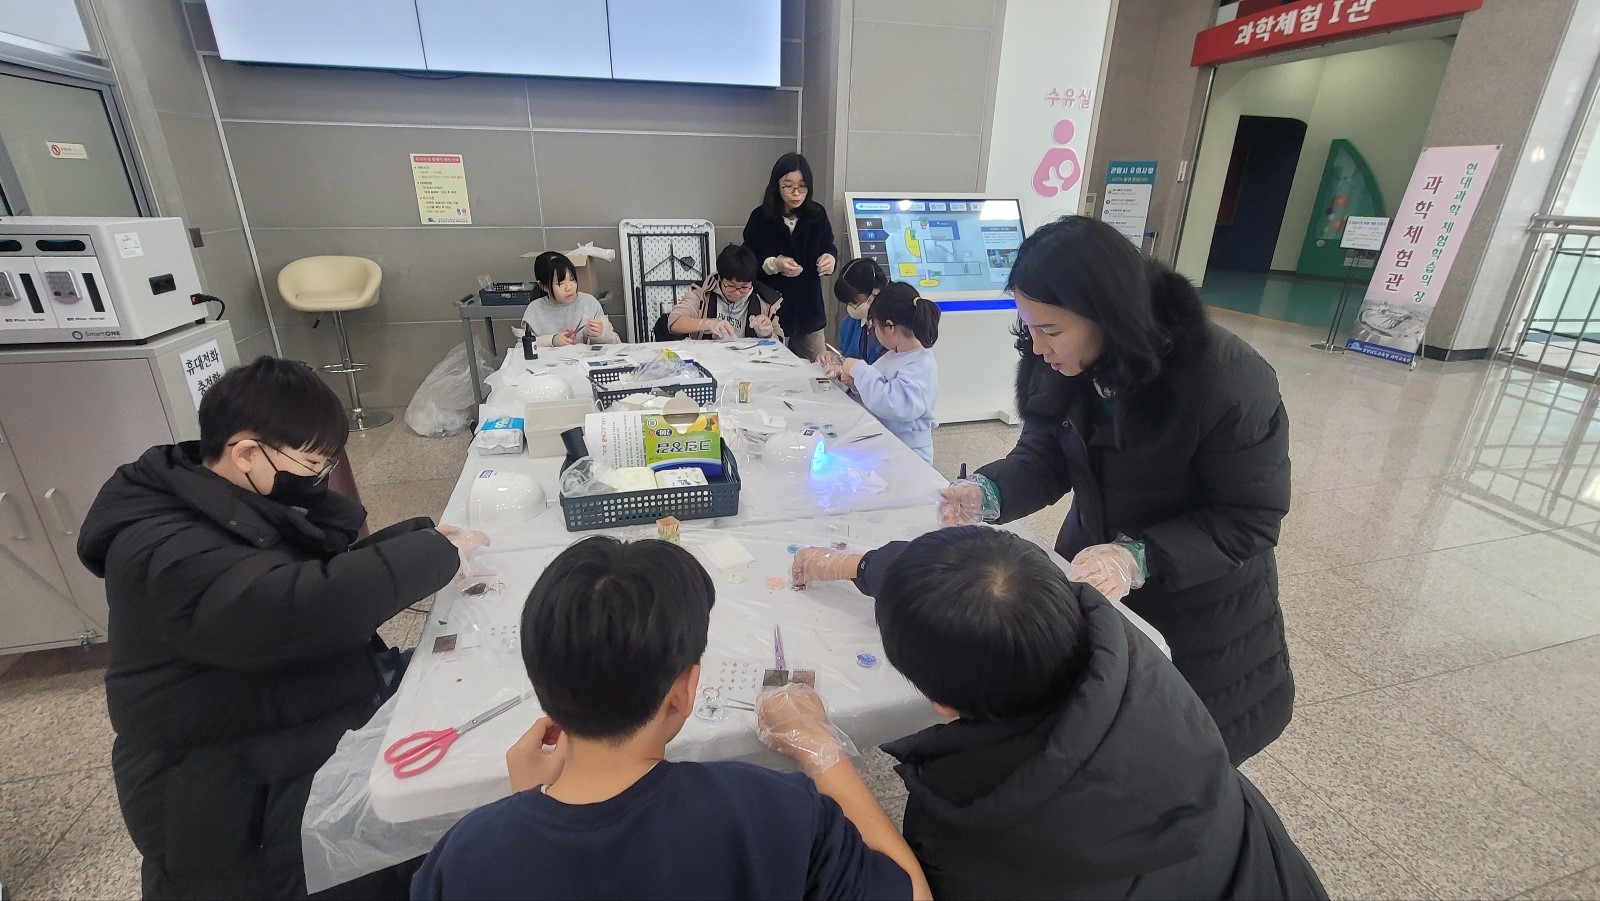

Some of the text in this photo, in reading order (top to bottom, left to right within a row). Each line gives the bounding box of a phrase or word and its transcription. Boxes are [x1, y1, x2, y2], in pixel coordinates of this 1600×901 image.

[1234, 2, 1323, 46] 과학체험
[1046, 86, 1092, 109] 수유실
[1384, 175, 1444, 292] 과학체험관
[1413, 162, 1479, 303] 현대과학 체험학습의 장
[185, 347, 220, 377] 휴대전화
[655, 439, 713, 454] 크린장갑
